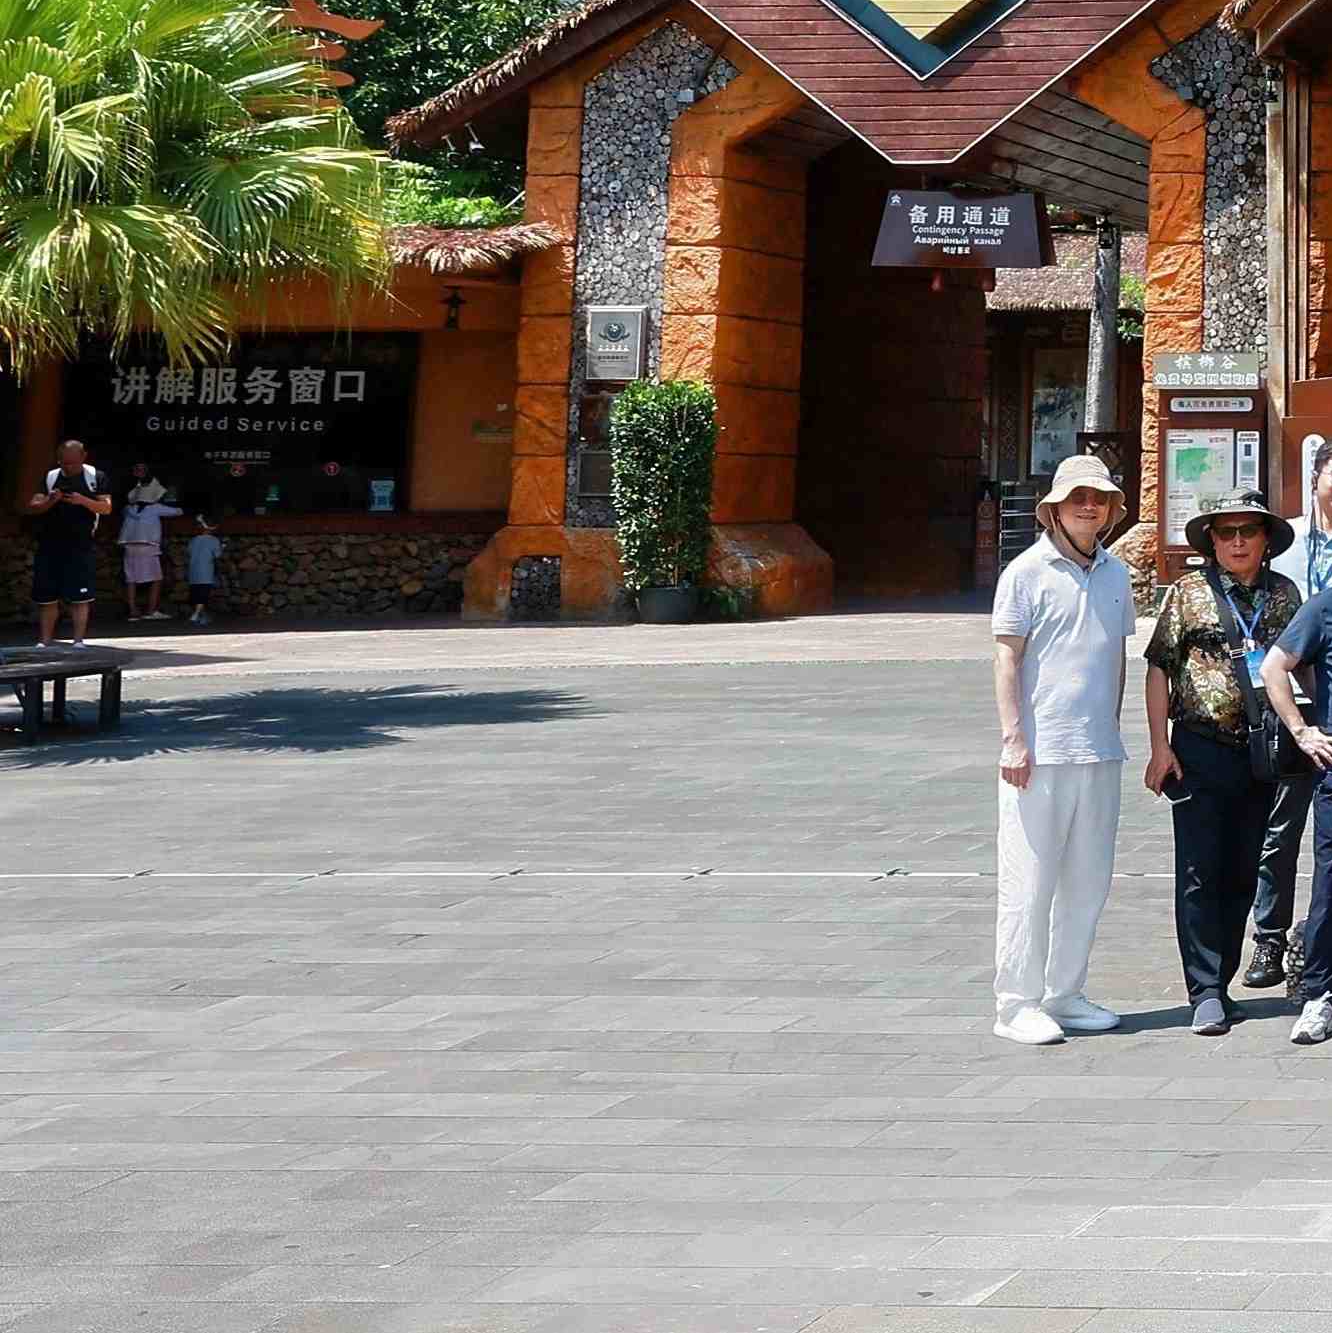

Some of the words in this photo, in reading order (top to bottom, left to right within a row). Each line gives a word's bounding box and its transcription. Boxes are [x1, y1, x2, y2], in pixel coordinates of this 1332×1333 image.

[908, 204, 1011, 226] 备用通道
[912, 224, 967, 236] Contingency
[969, 226, 1005, 237] Passage
[913, 235, 969, 247] Аварийный
[973, 237, 1002, 245] канал
[1173, 354, 1239, 370] 槟榔谷
[111, 365, 366, 405] 讲解服务窗口
[146, 416, 229, 431] Guided
[236, 416, 325, 432] Service
